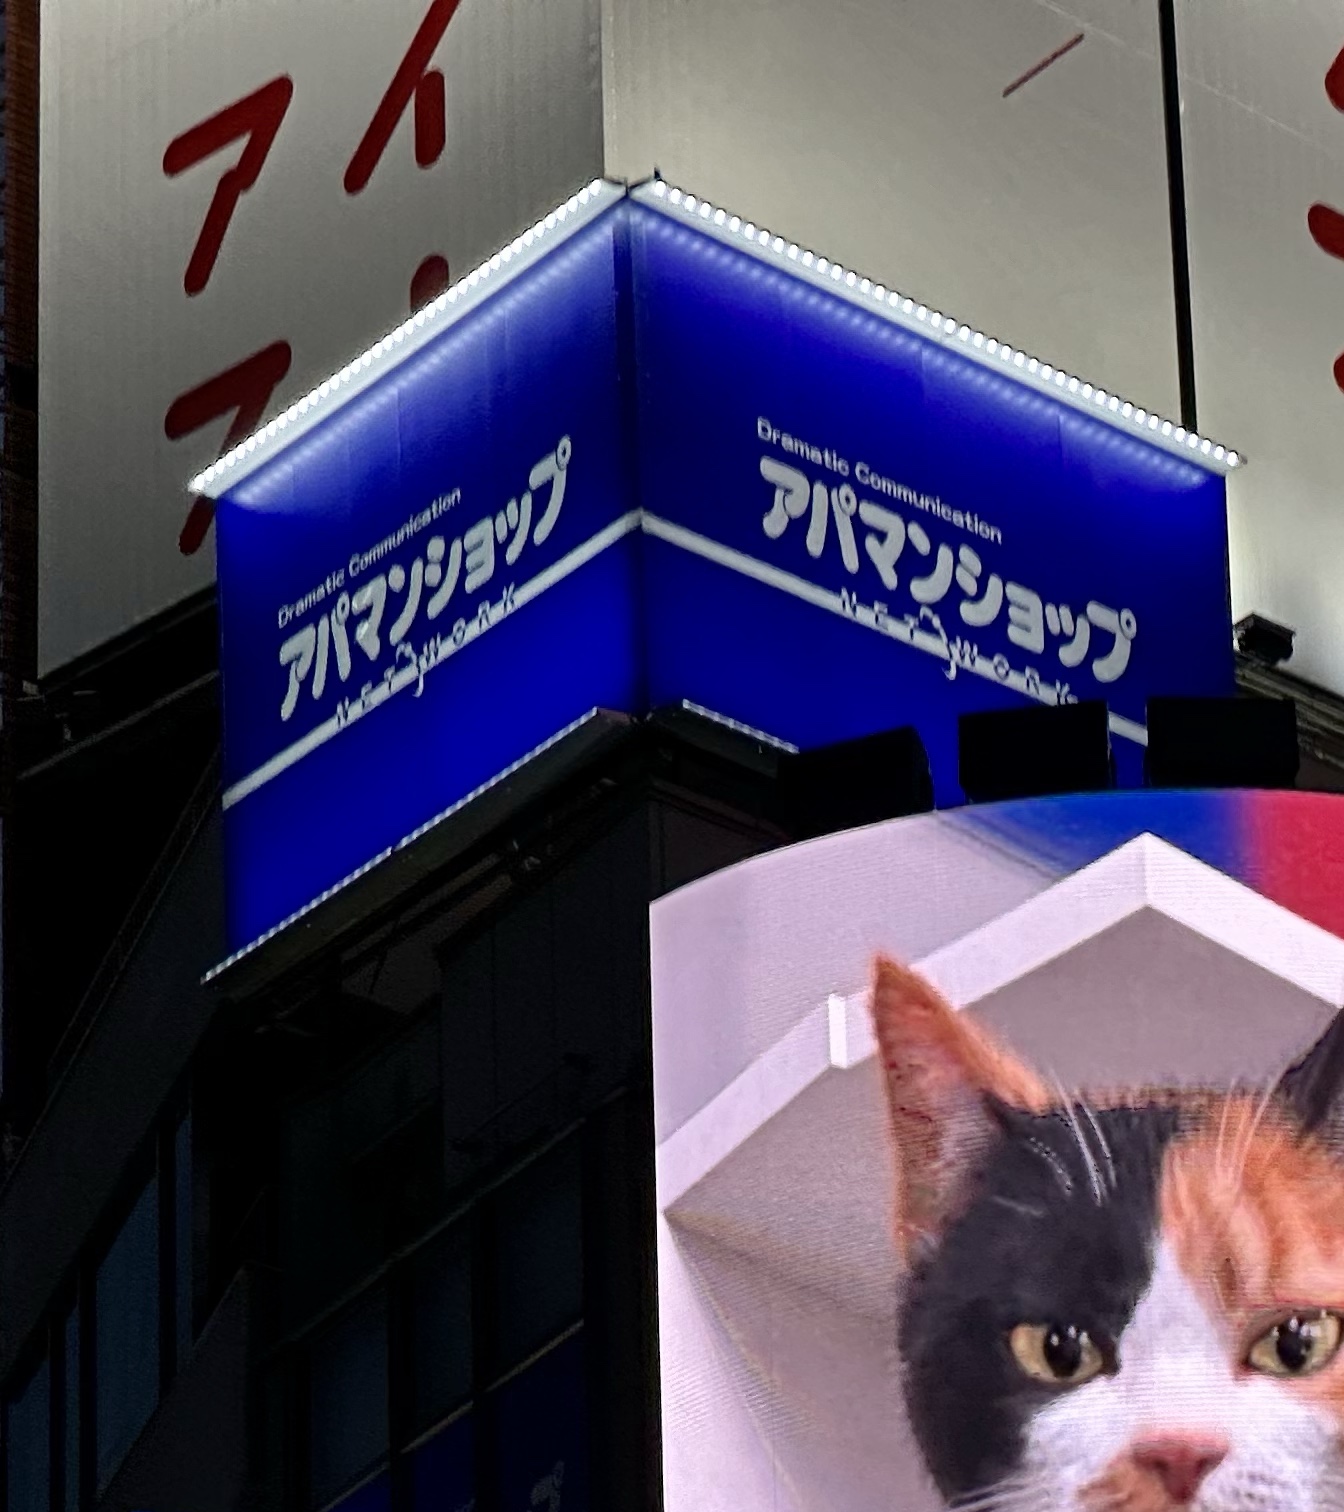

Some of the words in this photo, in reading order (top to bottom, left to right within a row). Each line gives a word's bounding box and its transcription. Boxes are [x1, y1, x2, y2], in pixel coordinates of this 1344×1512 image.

[277, 567, 346, 630] Dramatic
[348, 487, 462, 578] Communication
[757, 416, 850, 477] Dramatic
[855, 461, 1003, 545] Communication
[759, 455, 1138, 684] アパマンショップ
[279, 435, 572, 723] アパマンショップ
